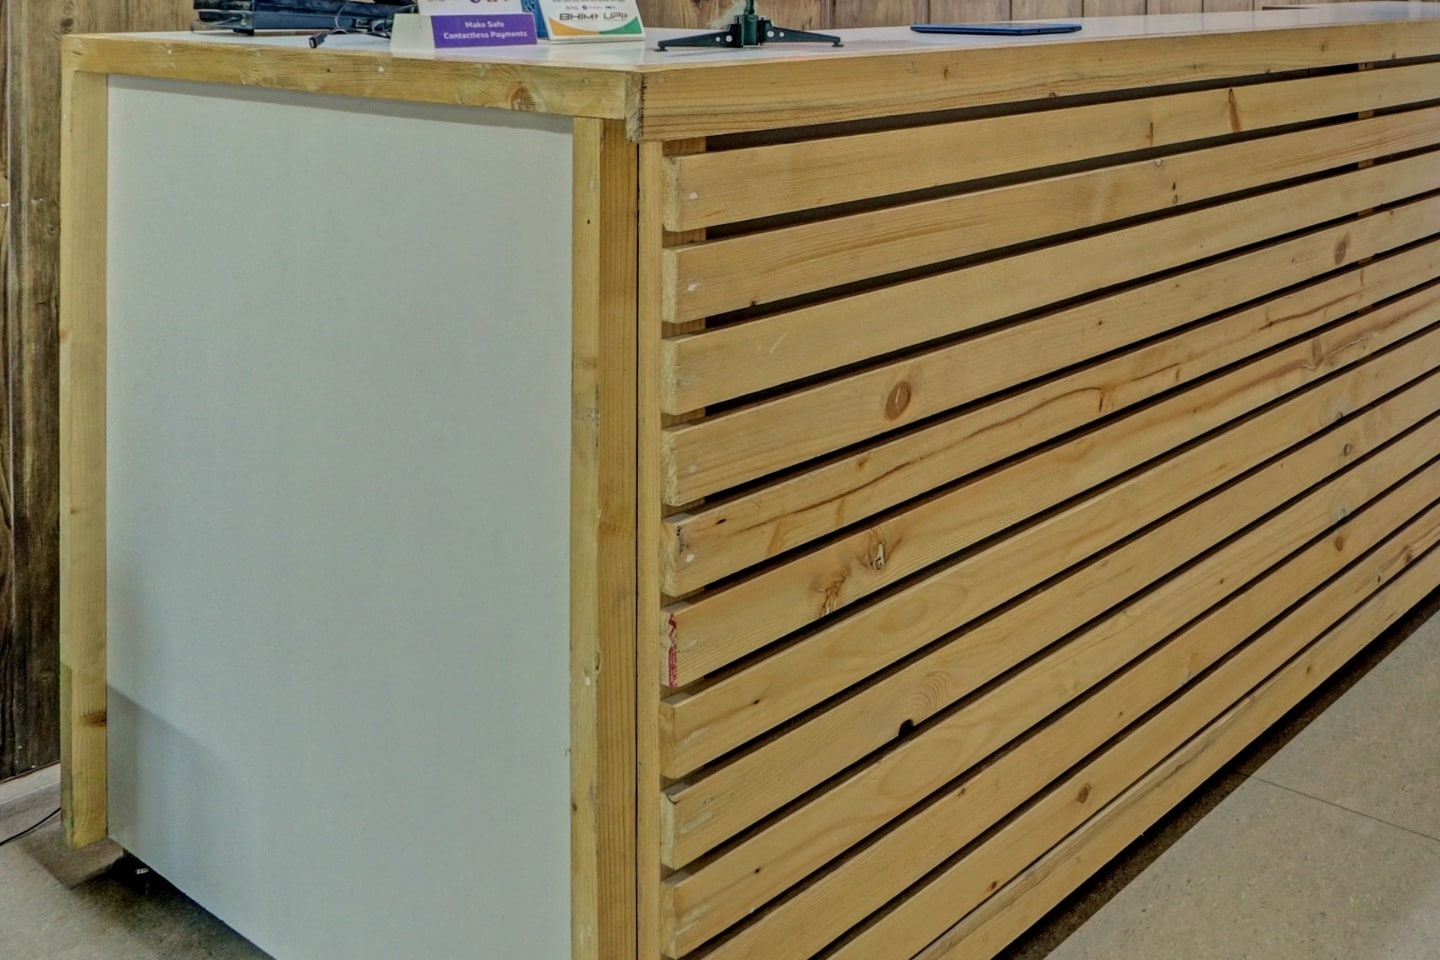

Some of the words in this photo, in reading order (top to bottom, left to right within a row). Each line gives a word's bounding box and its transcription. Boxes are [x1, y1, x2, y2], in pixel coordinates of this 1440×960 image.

[603, 12, 625, 20] UPI
[443, 31, 490, 40] Contactless
[490, 31, 528, 40] Payments
